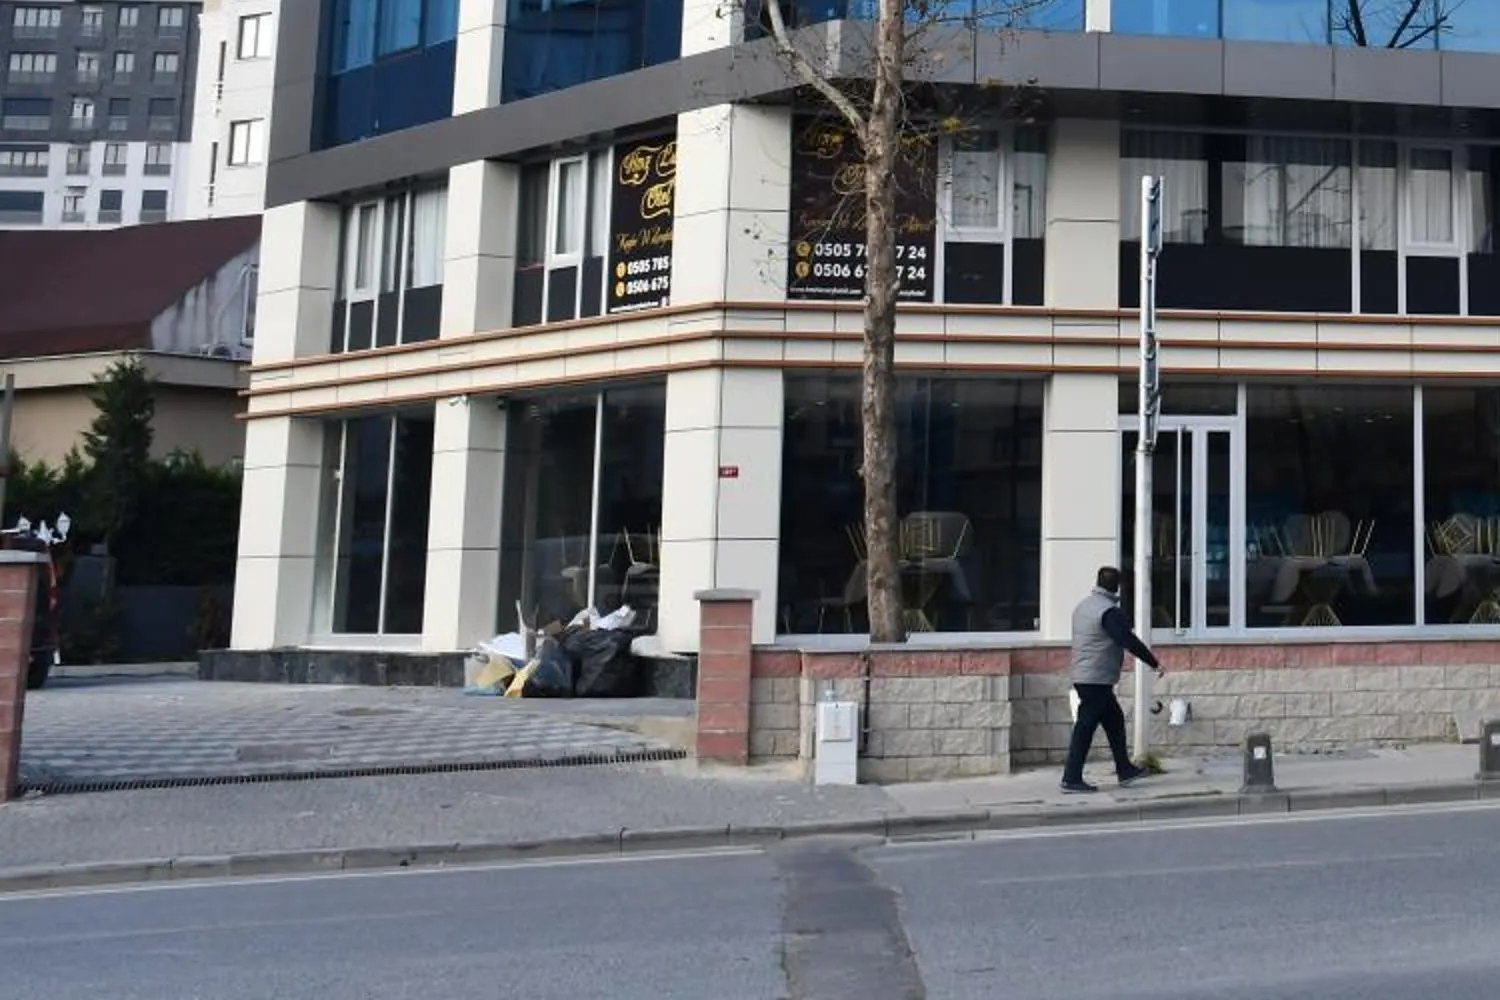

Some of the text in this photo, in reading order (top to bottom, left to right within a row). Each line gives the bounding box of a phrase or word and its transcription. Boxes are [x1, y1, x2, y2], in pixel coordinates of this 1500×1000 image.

[814, 243, 851, 257] 0505
[908, 246, 927, 259] 24
[813, 263, 851, 277] 0506
[907, 266, 926, 279] 24
